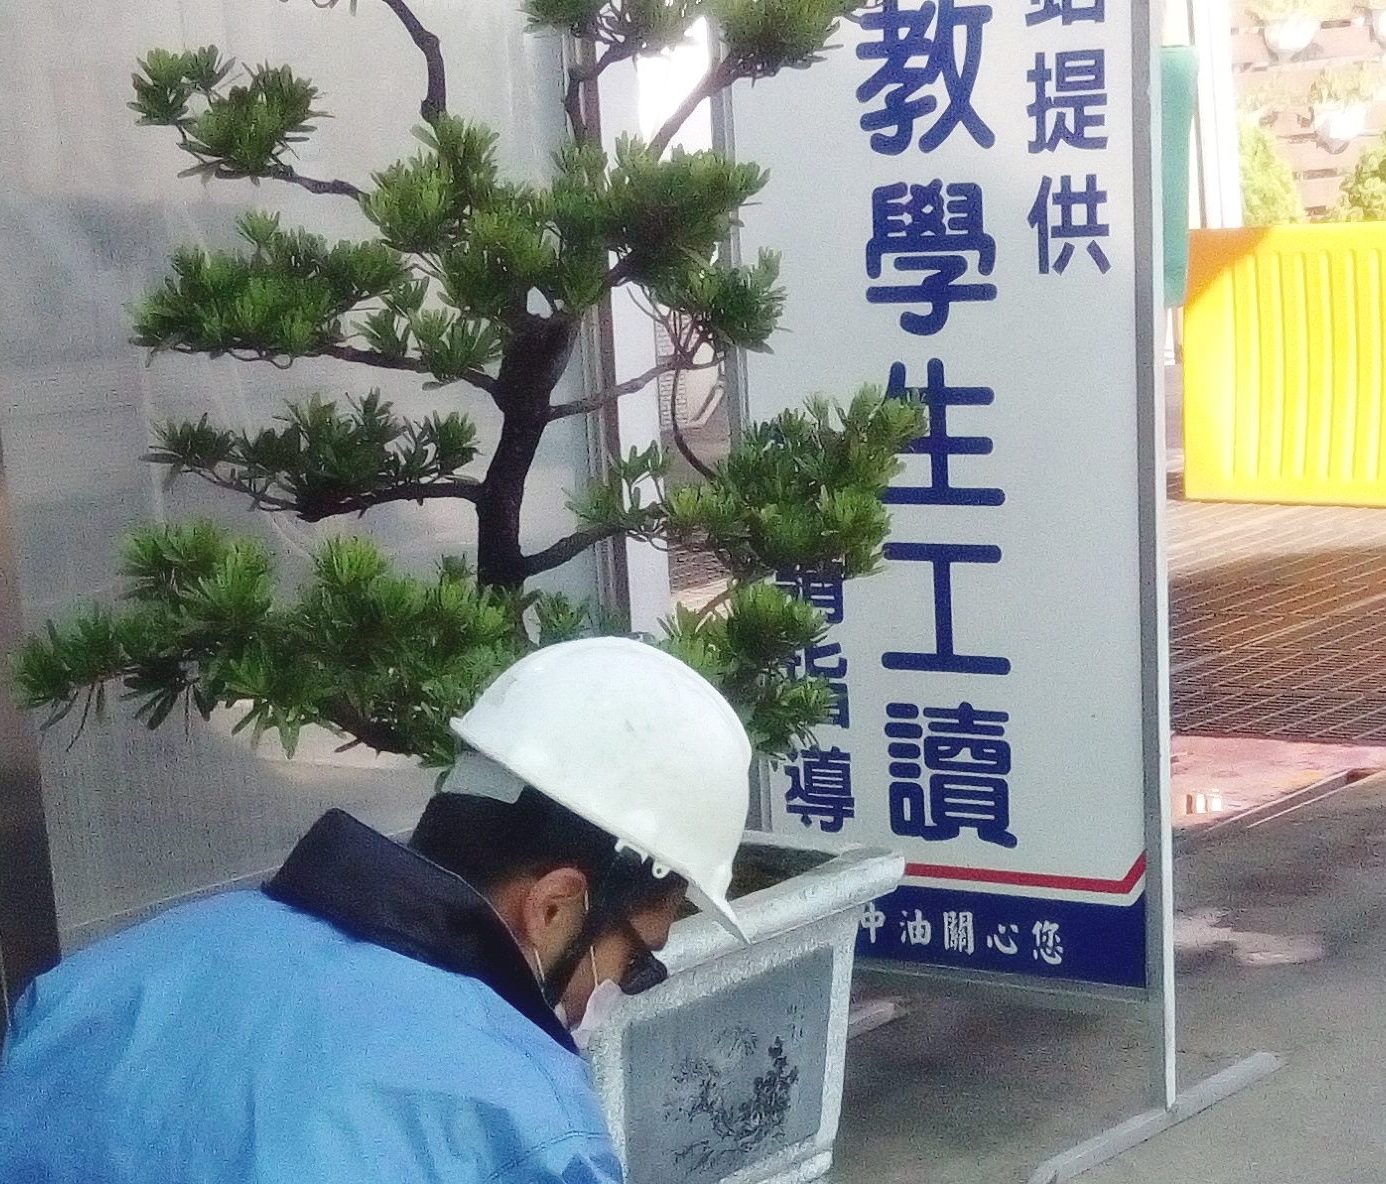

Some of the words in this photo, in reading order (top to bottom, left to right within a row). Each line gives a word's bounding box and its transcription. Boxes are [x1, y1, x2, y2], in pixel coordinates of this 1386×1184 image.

[1025, 0, 1110, 275] 提供
[856, 0, 1017, 848] 教學生工讀
[860, 901, 1063, 965] 中油關心您
